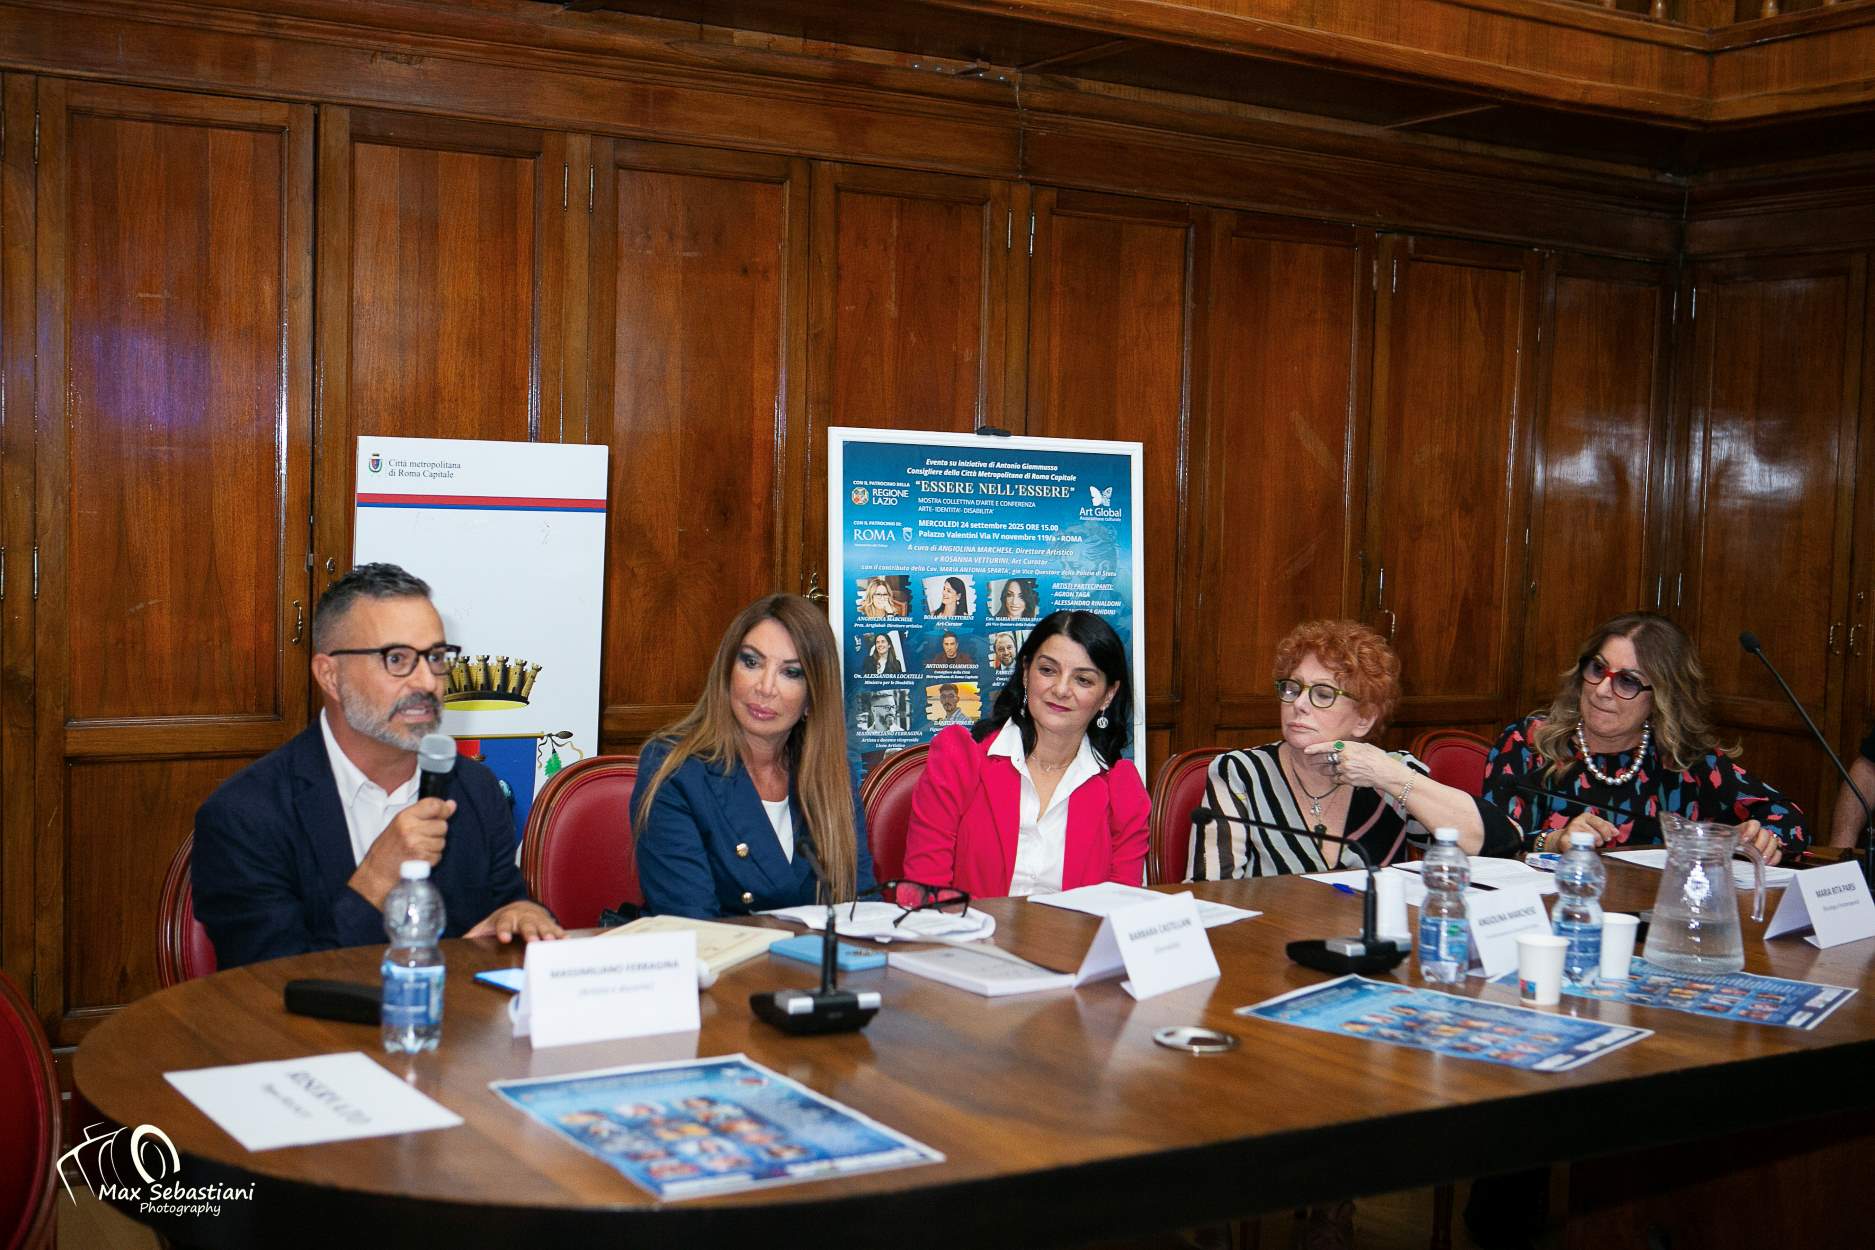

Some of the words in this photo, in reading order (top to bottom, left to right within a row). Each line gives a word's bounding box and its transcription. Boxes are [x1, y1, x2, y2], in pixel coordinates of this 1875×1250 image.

[409, 460, 461, 470] metropolitana
[926, 458, 948, 466] Evento
[958, 459, 987, 468] iniziativa
[996, 462, 1021, 470] Antonio
[388, 468, 396, 477] di
[398, 469, 421, 477] Roma
[422, 470, 454, 479] Capitale
[907, 467, 943, 476] Consigliere
[944, 468, 960, 476] della
[978, 470, 1023, 480] Metropolitana
[1050, 474, 1077, 482] Capitale
[872, 489, 909, 498] REGIONE
[872, 498, 898, 506] LAZIO
[1079, 507, 1093, 516] Art
[1094, 508, 1122, 517] Global
[970, 522, 1008, 530] settembre
[1041, 524, 1059, 532] 15.00
[853, 528, 896, 541] ROMA
[918, 530, 945, 538] Palazzo
[946, 531, 978, 539] Valentini
[980, 532, 991, 540] Via
[940, 556, 974, 564] ROSANNA
